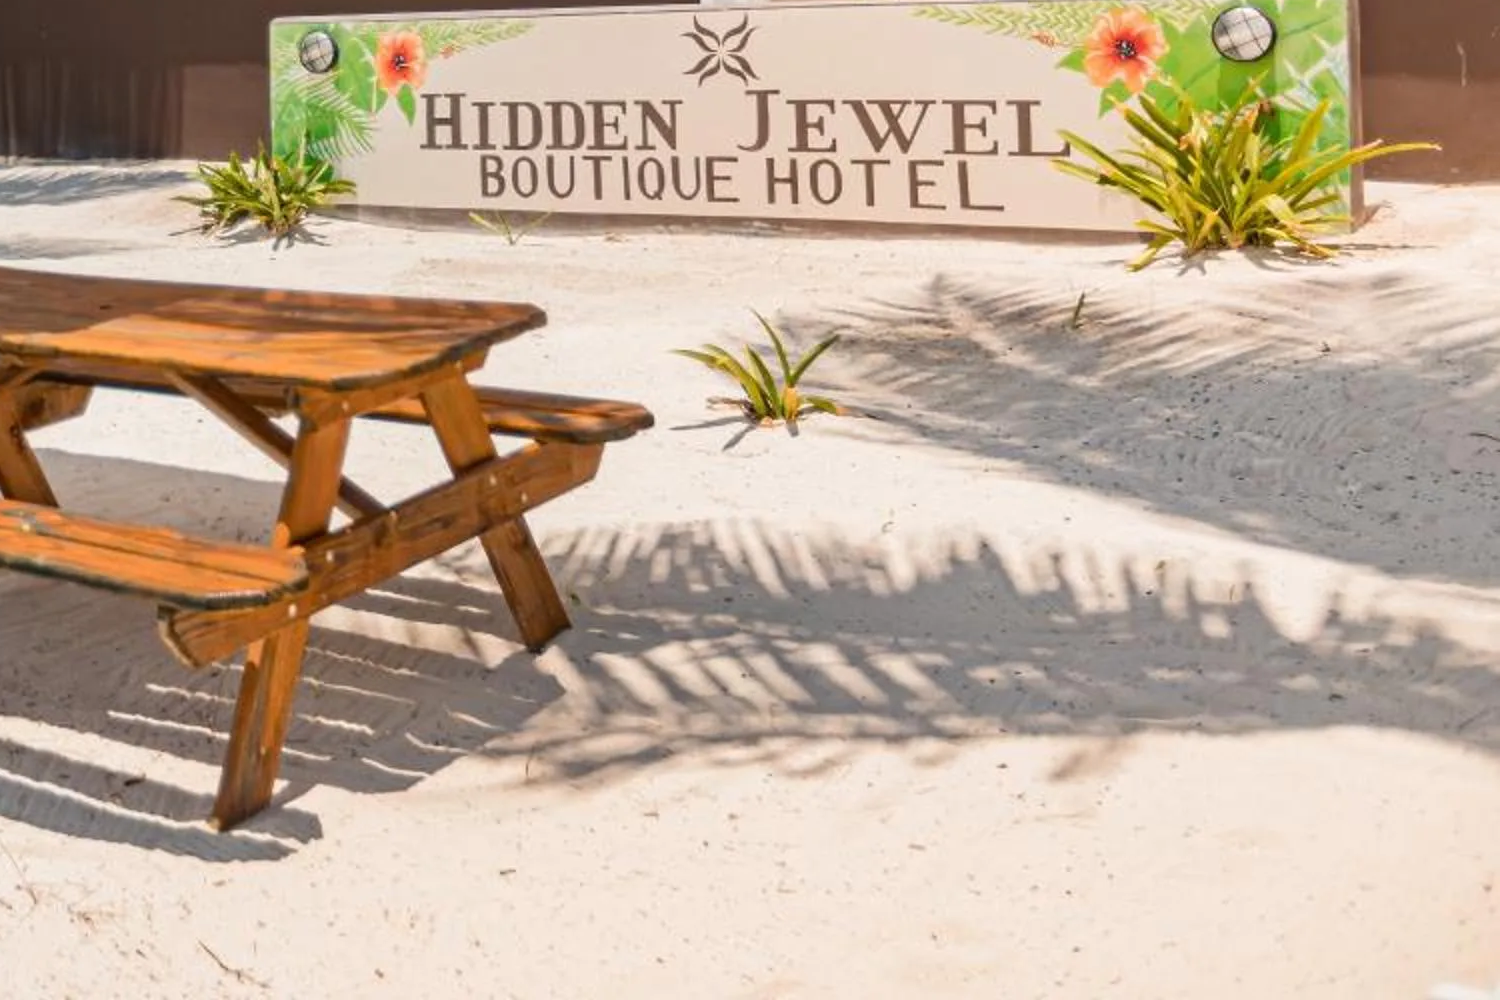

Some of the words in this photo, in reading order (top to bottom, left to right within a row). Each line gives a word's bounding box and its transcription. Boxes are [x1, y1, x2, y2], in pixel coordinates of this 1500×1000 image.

[419, 92, 684, 151] HIDDEN
[736, 88, 1072, 158] JEWEL
[480, 153, 740, 204] BOUTIQUE
[765, 156, 1005, 212] HOTEL
